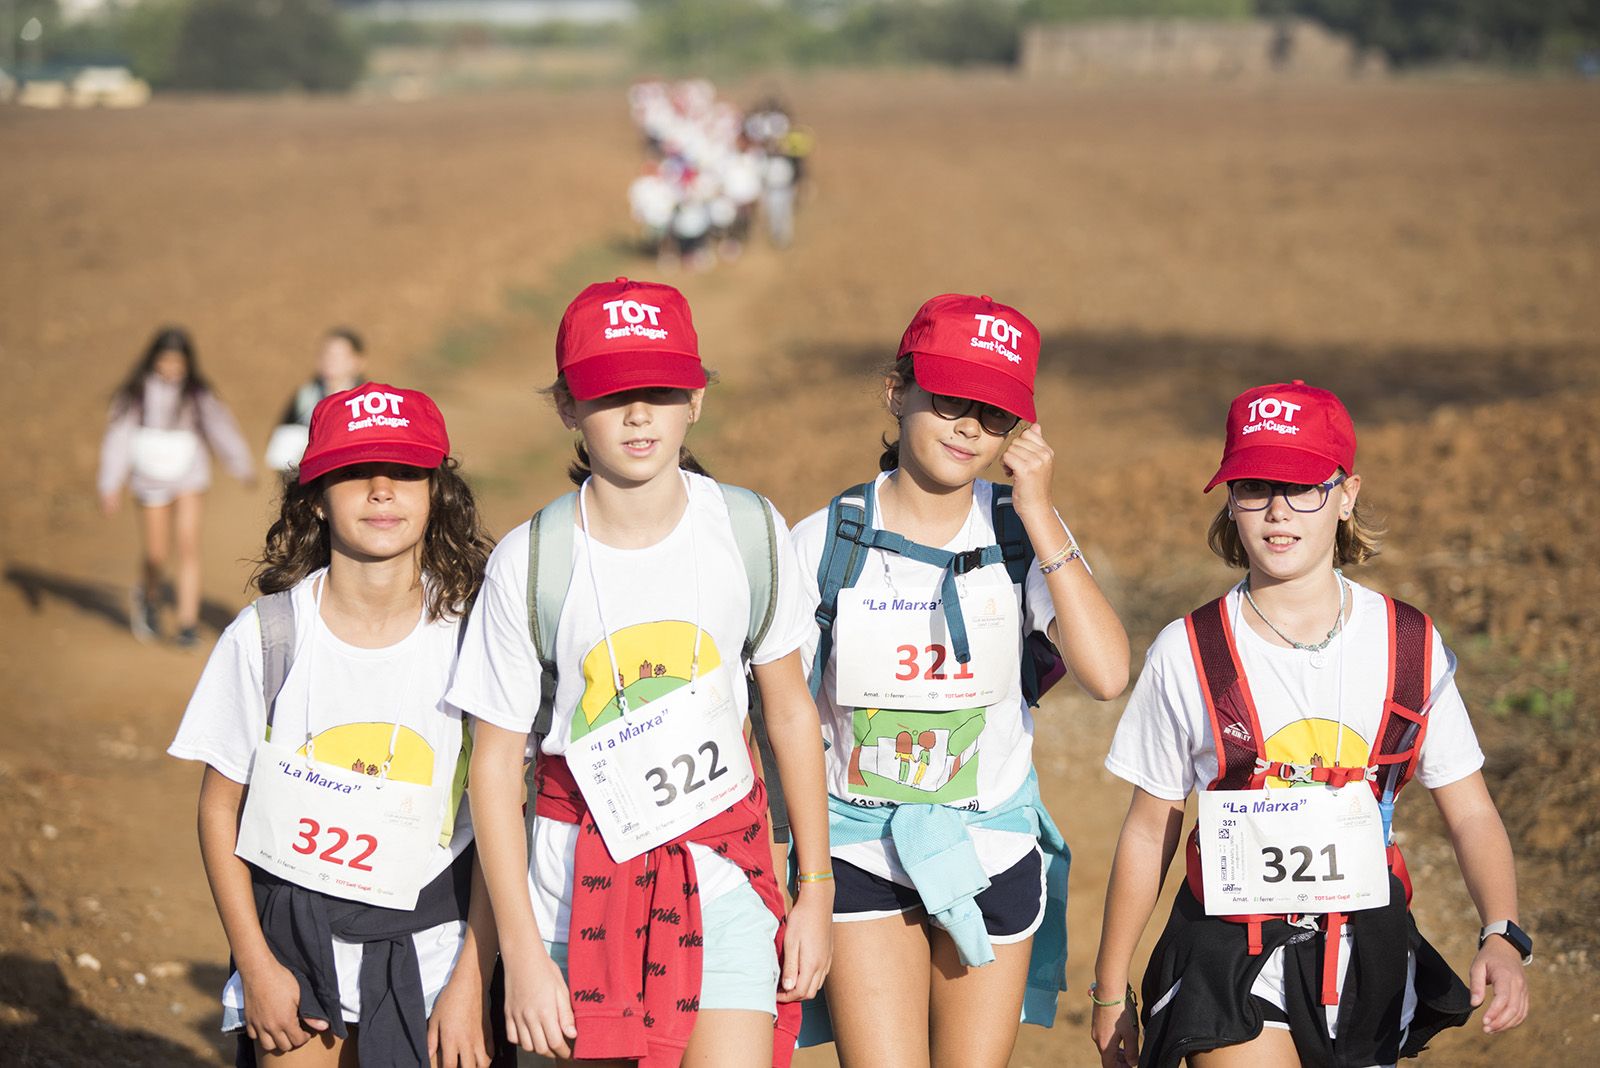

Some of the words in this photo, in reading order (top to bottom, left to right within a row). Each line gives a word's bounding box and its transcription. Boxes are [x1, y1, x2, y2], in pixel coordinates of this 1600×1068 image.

[603, 300, 661, 326] TOT
[974, 314, 1022, 350] TOT
[345, 391, 404, 419] TOT
[1247, 397, 1302, 422] TOT
[895, 643, 974, 681] 321
[592, 759, 607, 770] 322
[644, 740, 728, 807] 322
[292, 817, 378, 872] 322
[1261, 843, 1345, 883] 321
